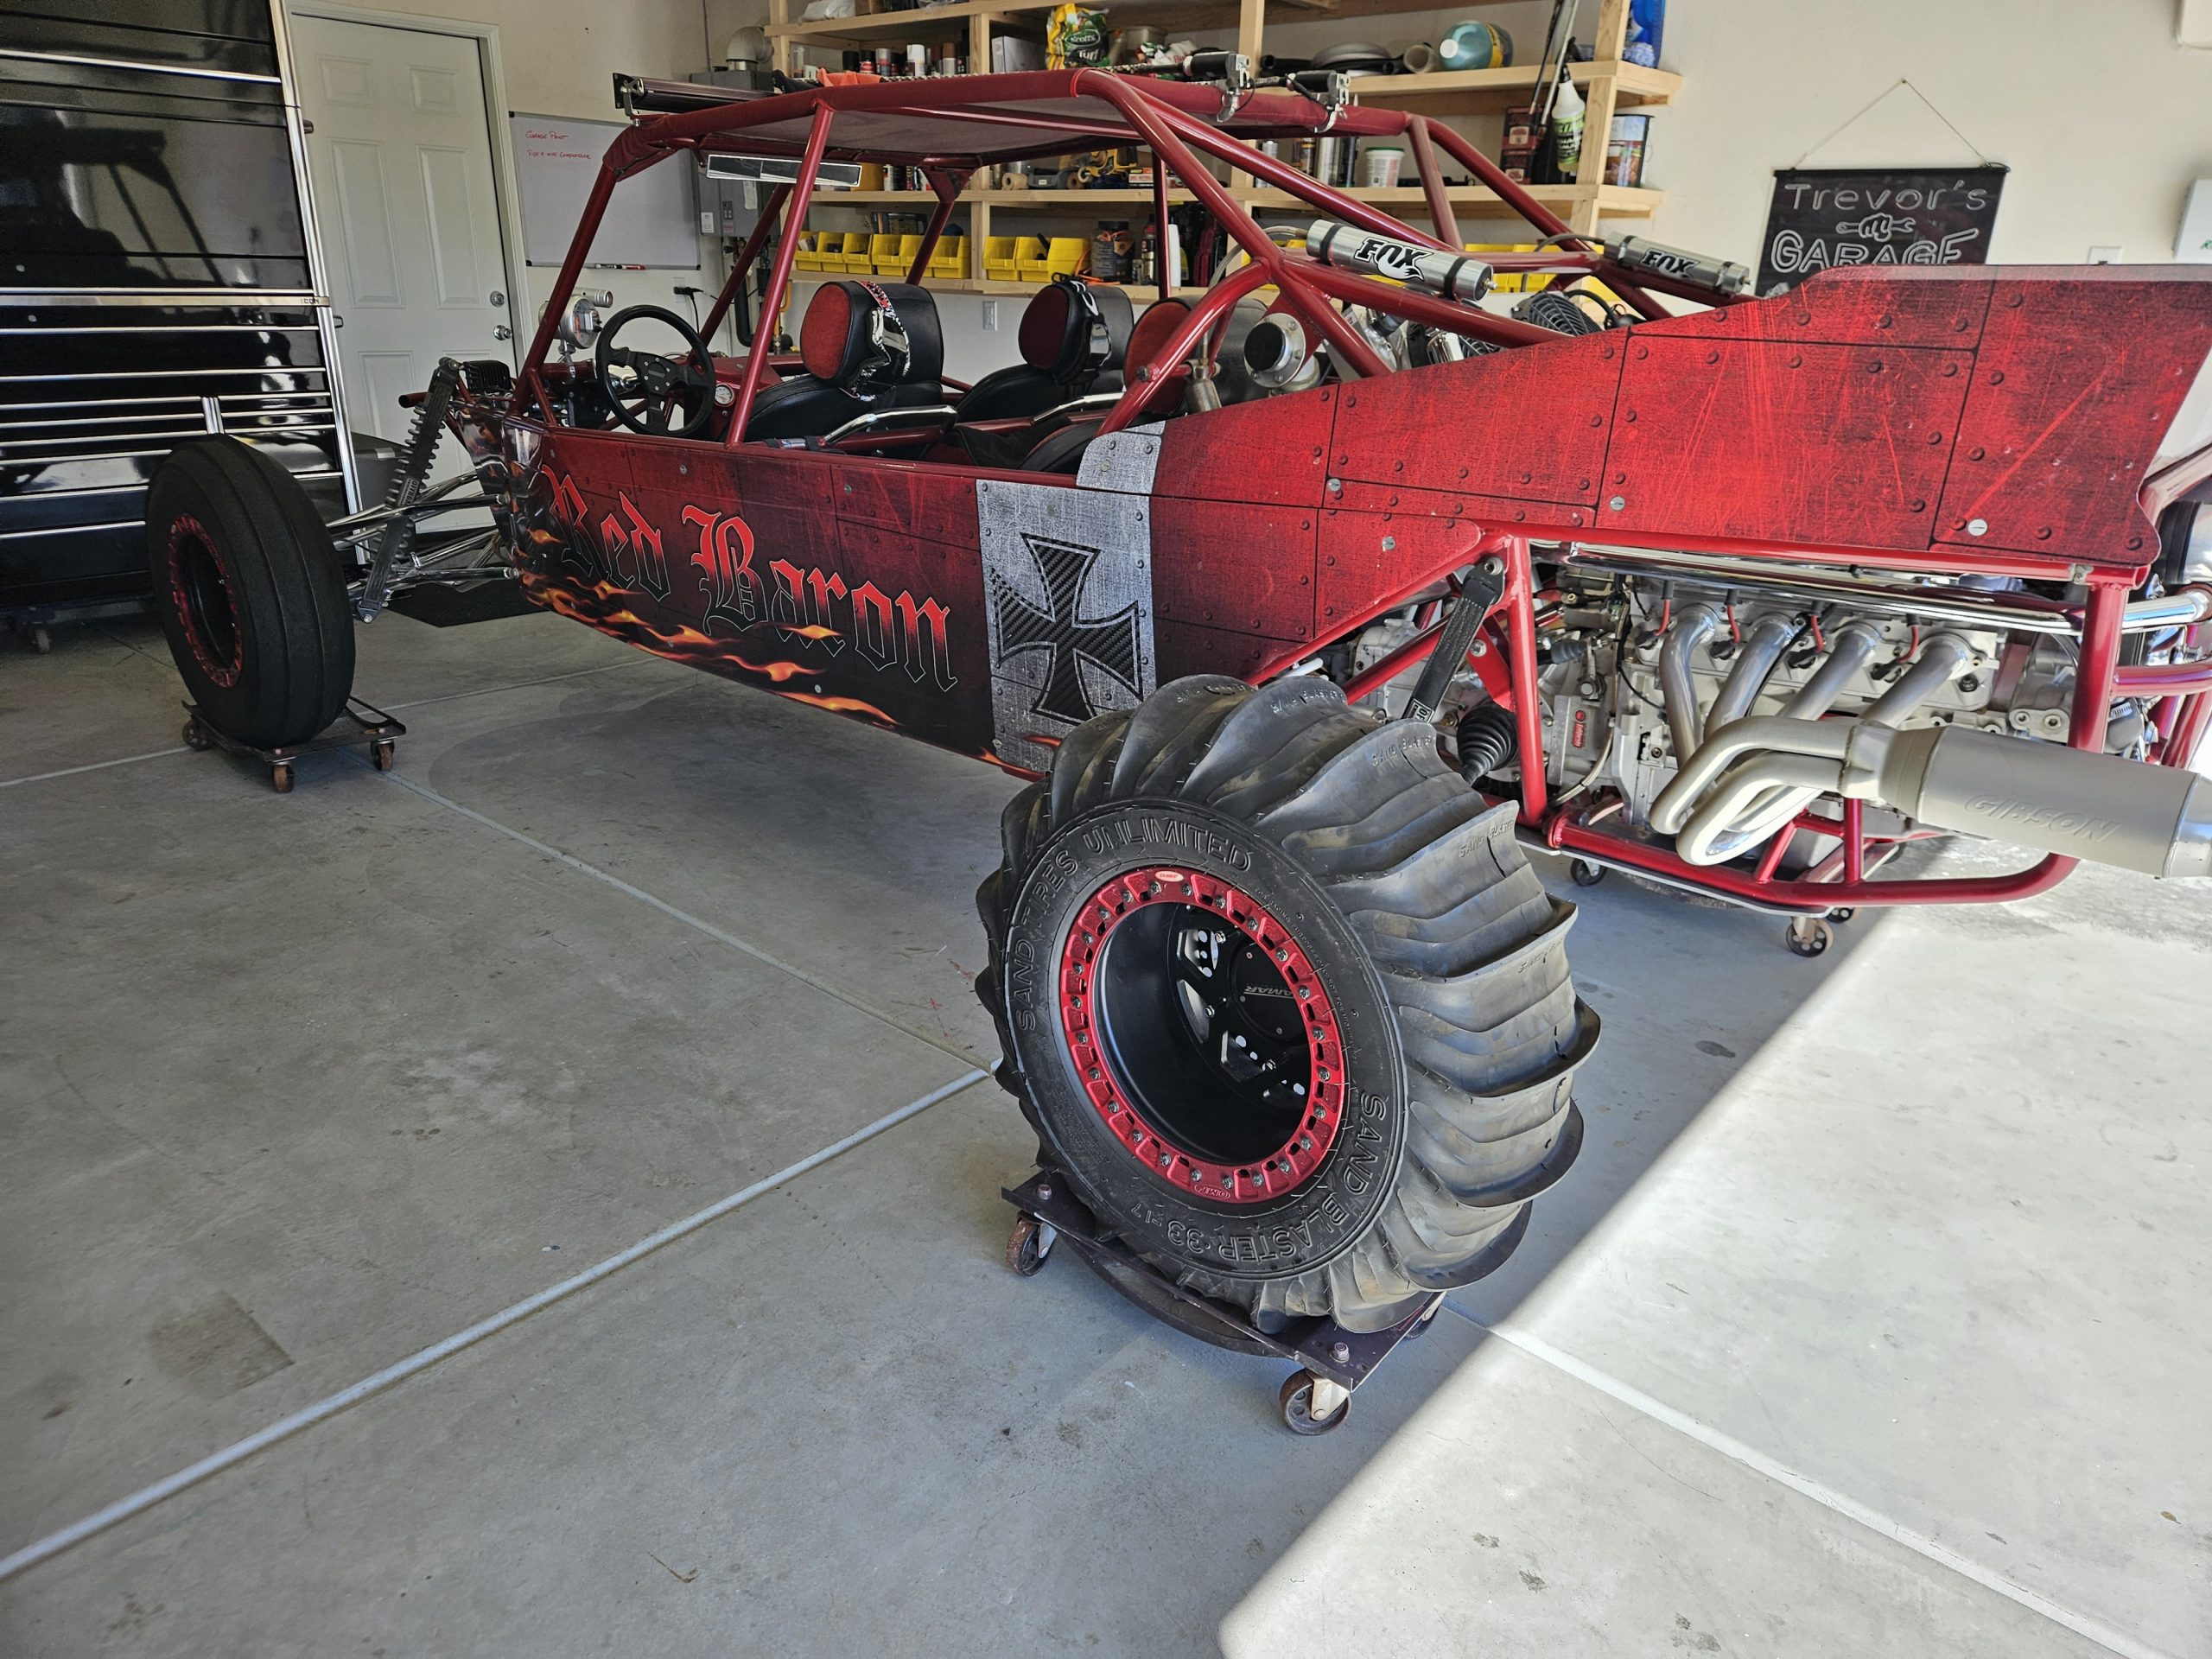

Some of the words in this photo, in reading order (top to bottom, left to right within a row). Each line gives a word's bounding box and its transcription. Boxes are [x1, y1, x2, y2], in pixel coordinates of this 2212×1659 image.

[1784, 180, 1986, 210] Trevor's
[1354, 237, 1433, 270] FOX
[1640, 247, 1700, 274] FOX
[1771, 229, 1979, 272] GARAGE
[542, 464, 671, 602] Red
[682, 504, 958, 691] Baron
[1964, 793, 2121, 842] GIBSON
[1082, 817, 1253, 872] UNLIMITED
[1022, 850, 1079, 926] TIRES
[1014, 939, 1037, 1031] SAND
[1244, 985, 1294, 996] AMAR
[1342, 1092, 1389, 1195] SAND
[1218, 1191, 1350, 1262] BLASTER
